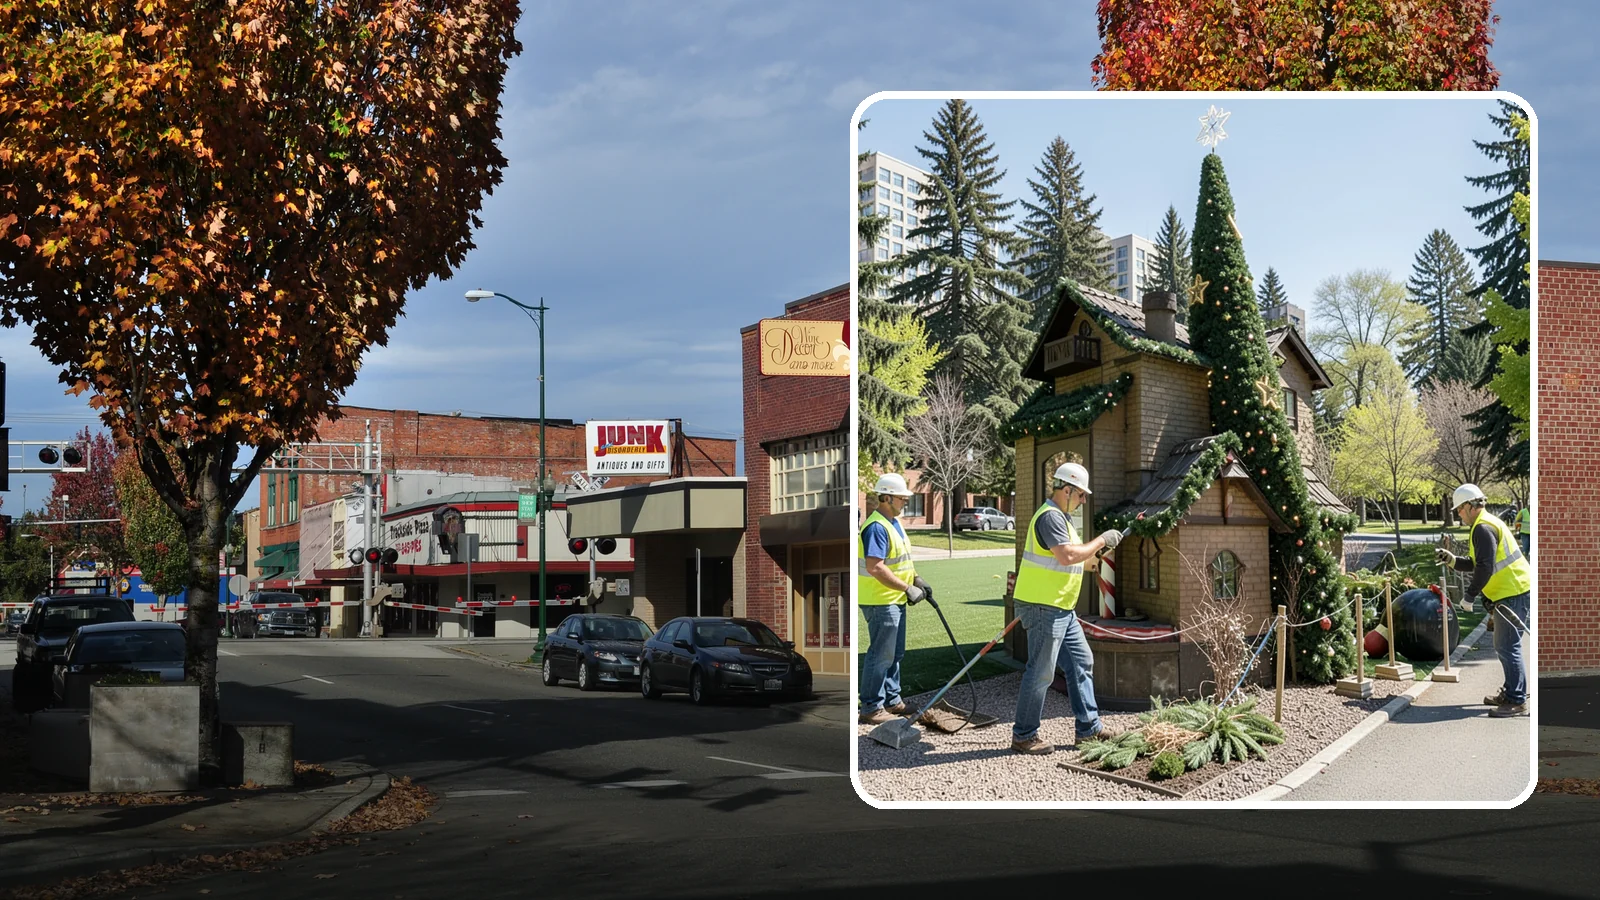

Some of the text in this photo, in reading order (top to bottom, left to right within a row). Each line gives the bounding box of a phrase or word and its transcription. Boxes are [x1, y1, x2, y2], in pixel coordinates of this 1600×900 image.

[595, 425, 664, 457] JUNK
[607, 446, 646, 454] DISORDERLY
[596, 460, 665, 470] ANTIQUES AND GIFTS
[573, 473, 589, 492] RAIL
[414, 519, 429, 535] Pizza
